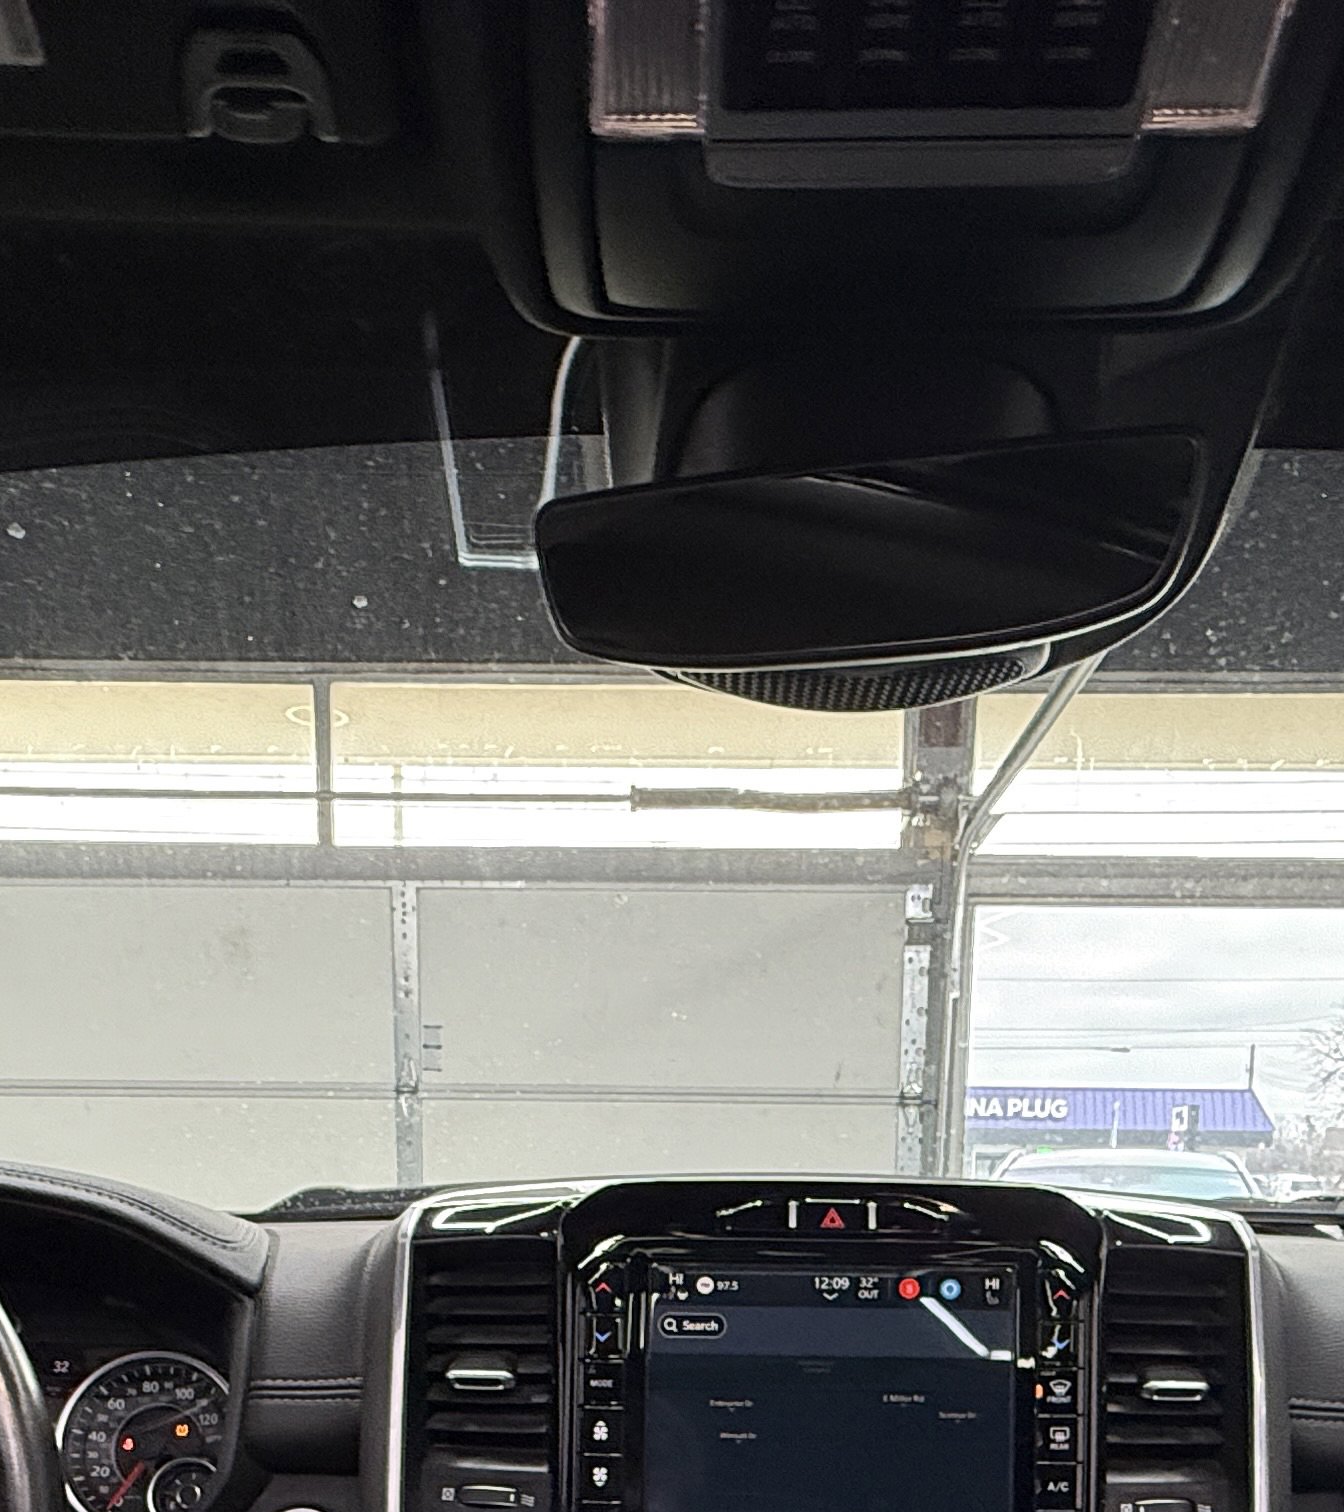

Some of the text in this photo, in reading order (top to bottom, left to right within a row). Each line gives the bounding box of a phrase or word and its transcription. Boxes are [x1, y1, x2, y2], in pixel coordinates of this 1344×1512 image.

[964, 1097, 1068, 1119] NA PLUG
[716, 1281, 739, 1291] 97.5
[814, 1276, 850, 1290] 12:09
[985, 1278, 1000, 1290] HI
[858, 1289, 879, 1299] OUT
[682, 1320, 719, 1332] Search
[54, 1361, 70, 1374] 32
[143, 1381, 159, 1393] 80
[589, 1379, 613, 1388] MODE
[175, 1388, 195, 1400] 100
[107, 1398, 125, 1410] 60
[199, 1413, 218, 1425] 120
[88, 1431, 106, 1442] 40
[90, 1466, 111, 1477] 20
[1047, 1482, 1070, 1492] A/C
